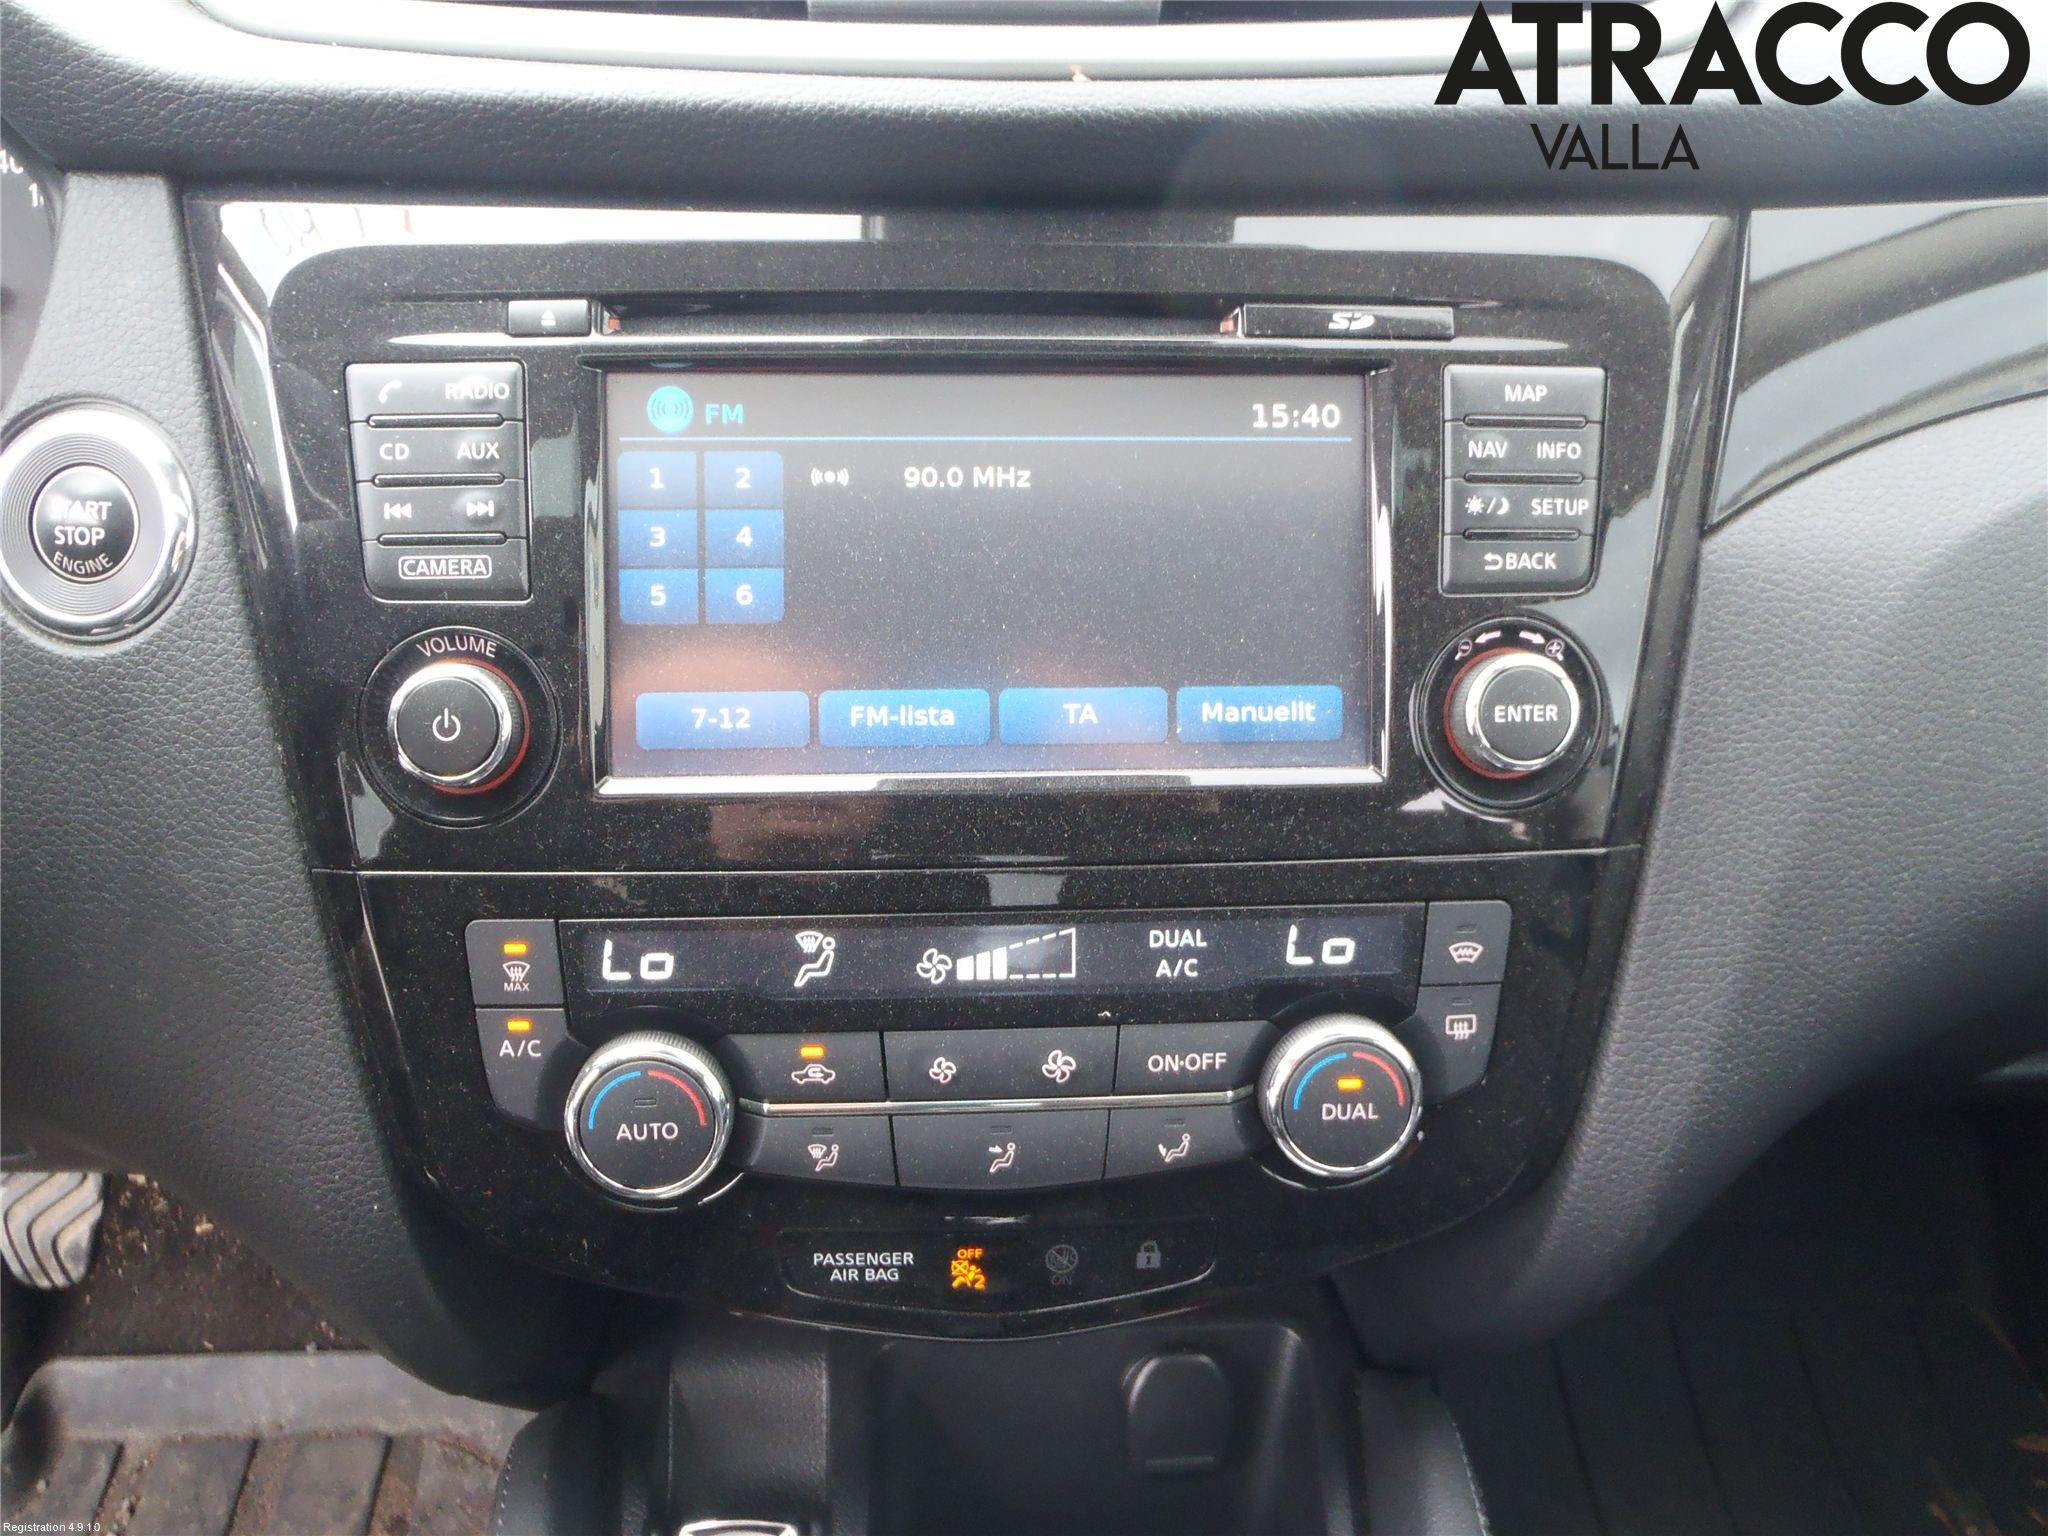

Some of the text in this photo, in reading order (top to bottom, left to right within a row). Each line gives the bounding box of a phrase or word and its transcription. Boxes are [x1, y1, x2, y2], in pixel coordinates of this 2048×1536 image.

[445, 382, 510, 401] RADIO
[1505, 384, 1548, 402] MAP
[705, 403, 744, 425] FM
[1251, 403, 1342, 429] 15:40
[379, 443, 410, 461] CD
[457, 442, 499, 460] AUX
[1468, 440, 1508, 459] NAV
[1537, 441, 1581, 460] INFO
[649, 468, 665, 489] 1
[735, 467, 751, 488] 2
[904, 466, 1031, 488] 90.0 MHz
[49, 500, 112, 520] TART
[1531, 498, 1589, 516] SETUP
[54, 525, 105, 546] STOP
[649, 526, 666, 547] 3
[735, 526, 753, 547] 4
[53, 551, 114, 574] ENGINE
[403, 559, 487, 576] CAMERA
[1506, 553, 1556, 570] BACK
[650, 585, 666, 606] 5
[736, 585, 753, 606] 6
[416, 637, 498, 658] VOLUME
[691, 708, 751, 729] 7-12
[850, 705, 955, 727] FM-lista
[1063, 703, 1098, 724] TA
[1202, 701, 1315, 723] Manuellt
[1494, 704, 1558, 723] ENTER
[1149, 929, 1207, 949] DUAL
[1155, 959, 1198, 978] A/C
[503, 981, 530, 992] MAX
[499, 1040, 541, 1057] A/C
[1321, 1102, 1379, 1121] DUAL
[616, 1122, 679, 1141] AUTO
[813, 1251, 914, 1267] PASSENGER
[957, 1248, 983, 1259] OFF
[830, 1267, 899, 1283] AIR BAG
